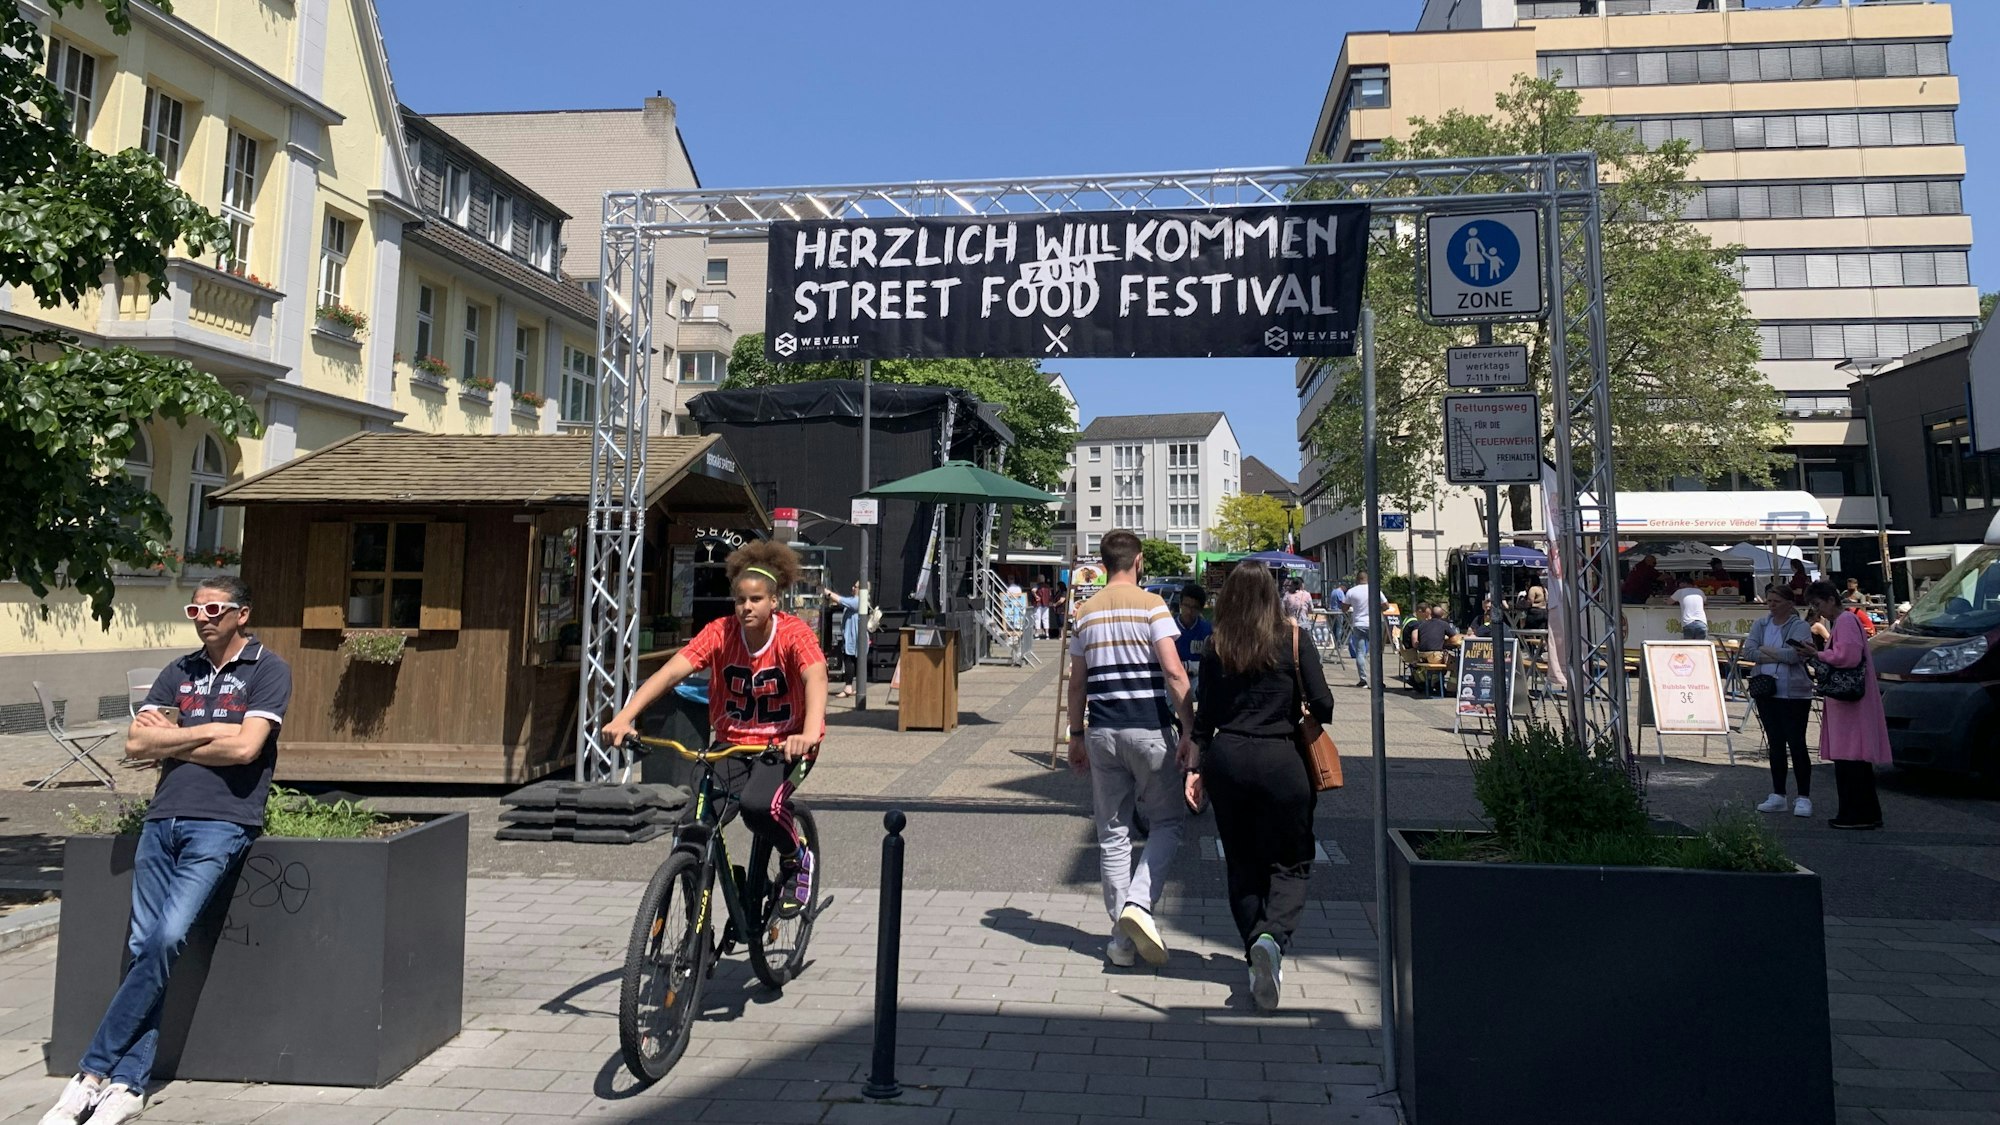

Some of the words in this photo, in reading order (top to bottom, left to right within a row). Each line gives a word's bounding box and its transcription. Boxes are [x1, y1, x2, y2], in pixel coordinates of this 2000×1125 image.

[795, 221, 1018, 269] HERZLICH
[1036, 214, 1339, 262] WILLKOMMEN
[1028, 259, 1090, 285] ZUM
[794, 277, 962, 323] STREET
[981, 276, 1100, 318] FOOD
[1119, 273, 1339, 318] FESTIVAL
[1457, 291, 1513, 309] ZONE
[801, 335, 859, 346] WEVENT
[1454, 350, 1520, 360] Lieferverkehr
[1465, 362, 1510, 371] werktags
[1494, 373, 1511, 382] frei
[1454, 403, 1528, 414] Rettungsweg
[1474, 421, 1487, 429] FÜR
[1489, 420, 1501, 429] DIE
[1475, 437, 1534, 446] FEUERWEHR
[1496, 453, 1536, 462] FREIHALTEN
[1649, 519, 1727, 527] Getränke-Service
[1730, 519, 1758, 527] Vendel
[1465, 650, 1480, 658] AUF
[722, 664, 792, 725] 92
[1680, 691, 1695, 704] 3€
